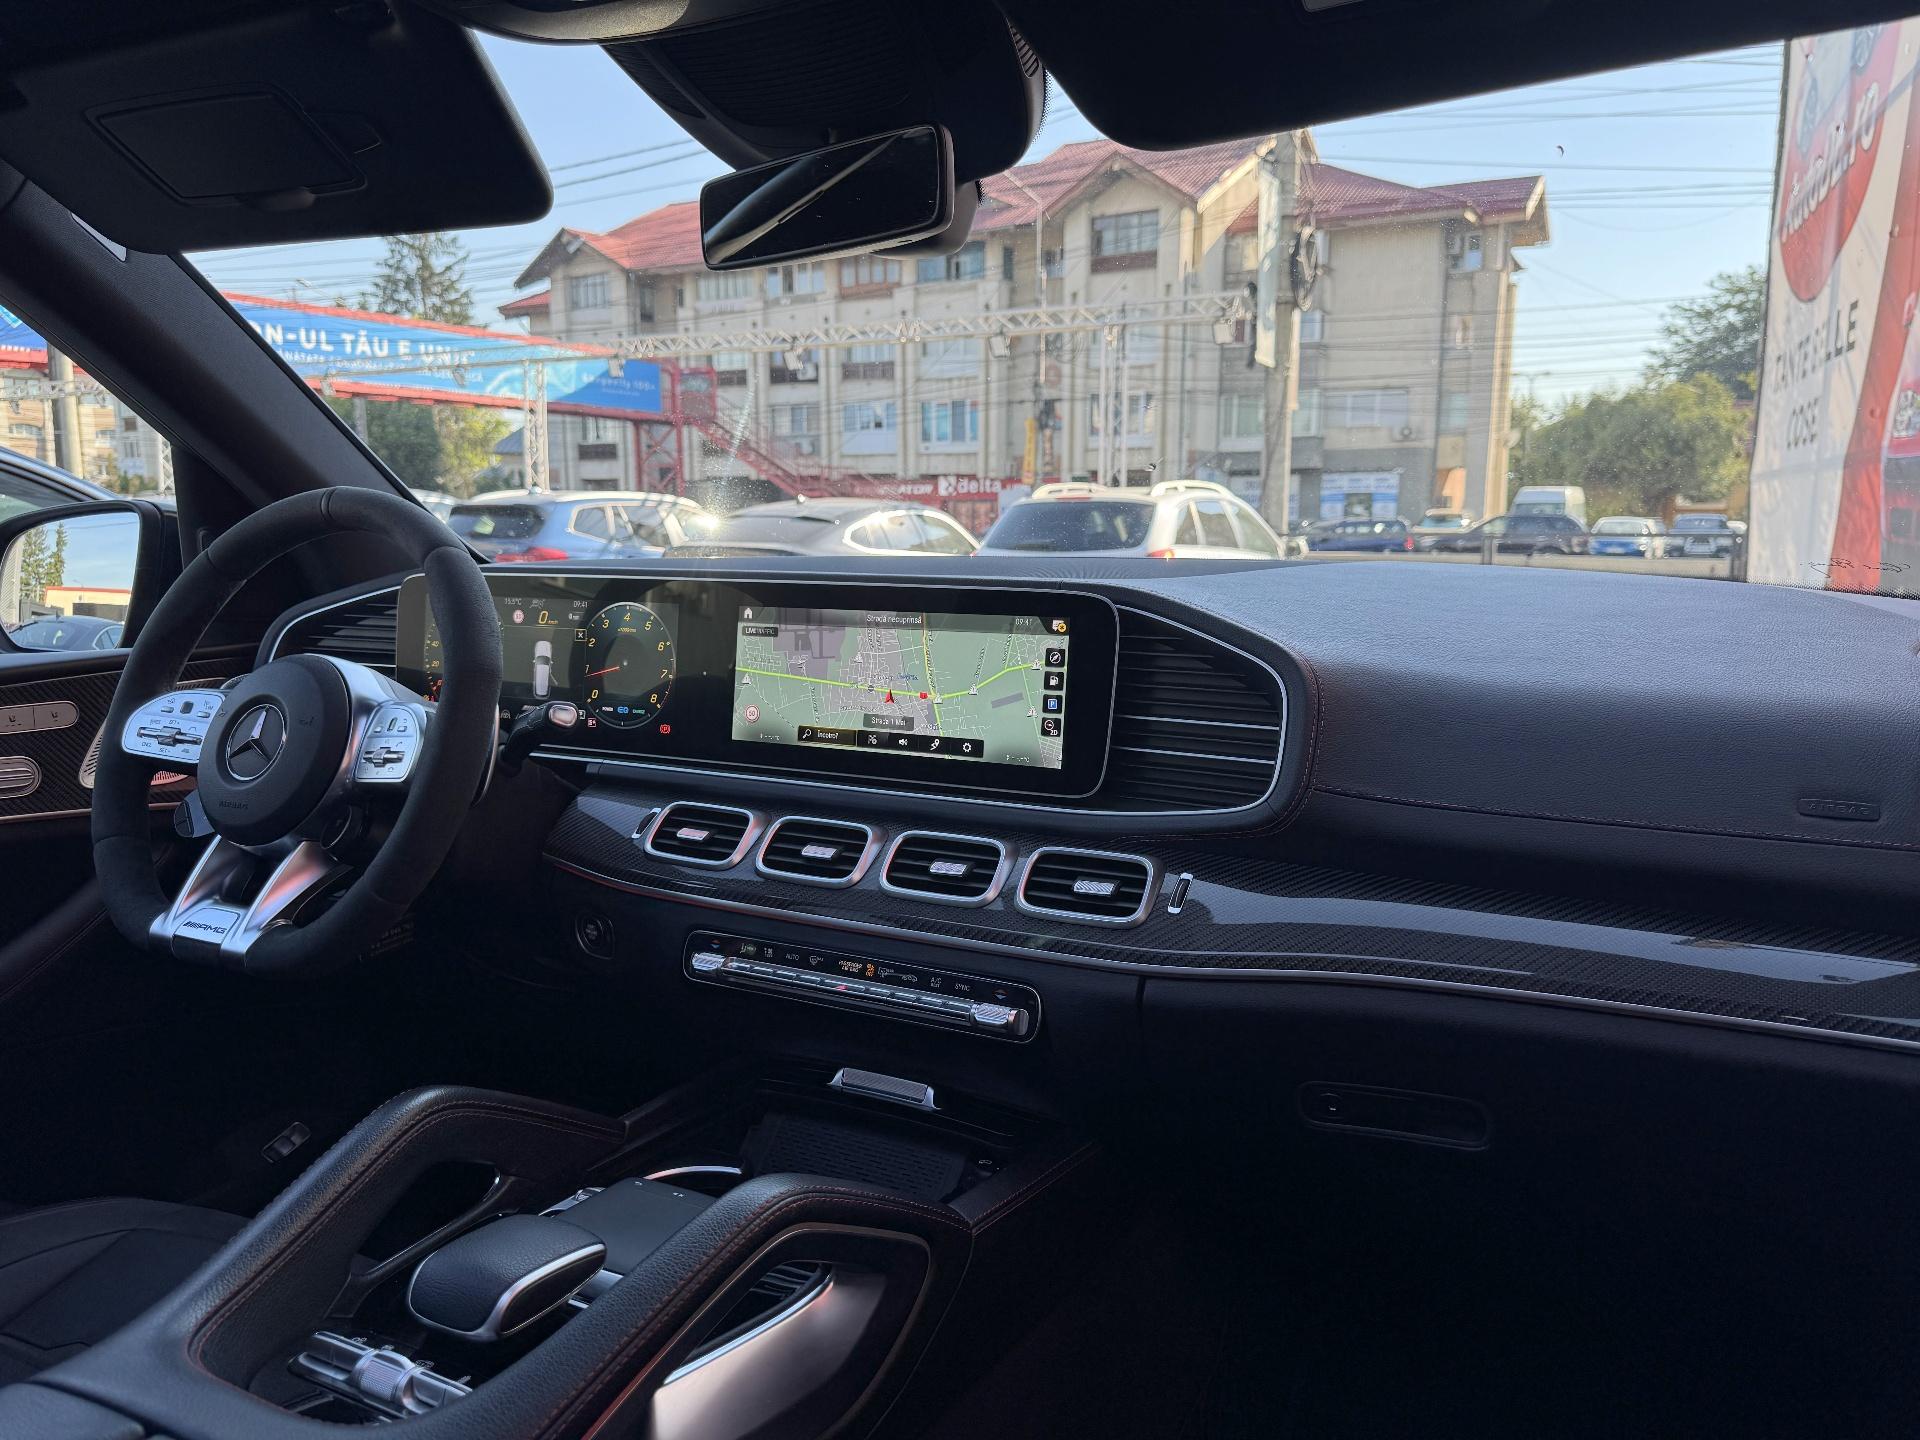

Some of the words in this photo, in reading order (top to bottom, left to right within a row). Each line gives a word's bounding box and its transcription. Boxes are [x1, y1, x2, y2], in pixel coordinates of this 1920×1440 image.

[341, 329, 390, 358] TĂU
[538, 610, 549, 624] 0
[624, 612, 631, 621] 4
[602, 619, 610, 629] 3
[644, 621, 653, 631] 5
[588, 638, 596, 648] 2
[657, 641, 665, 651] 6
[660, 669, 668, 679] 7
[591, 689, 599, 699] 0
[650, 693, 658, 703] 8
[786, 953, 800, 961] AUTO
[955, 983, 971, 992] SYNC
